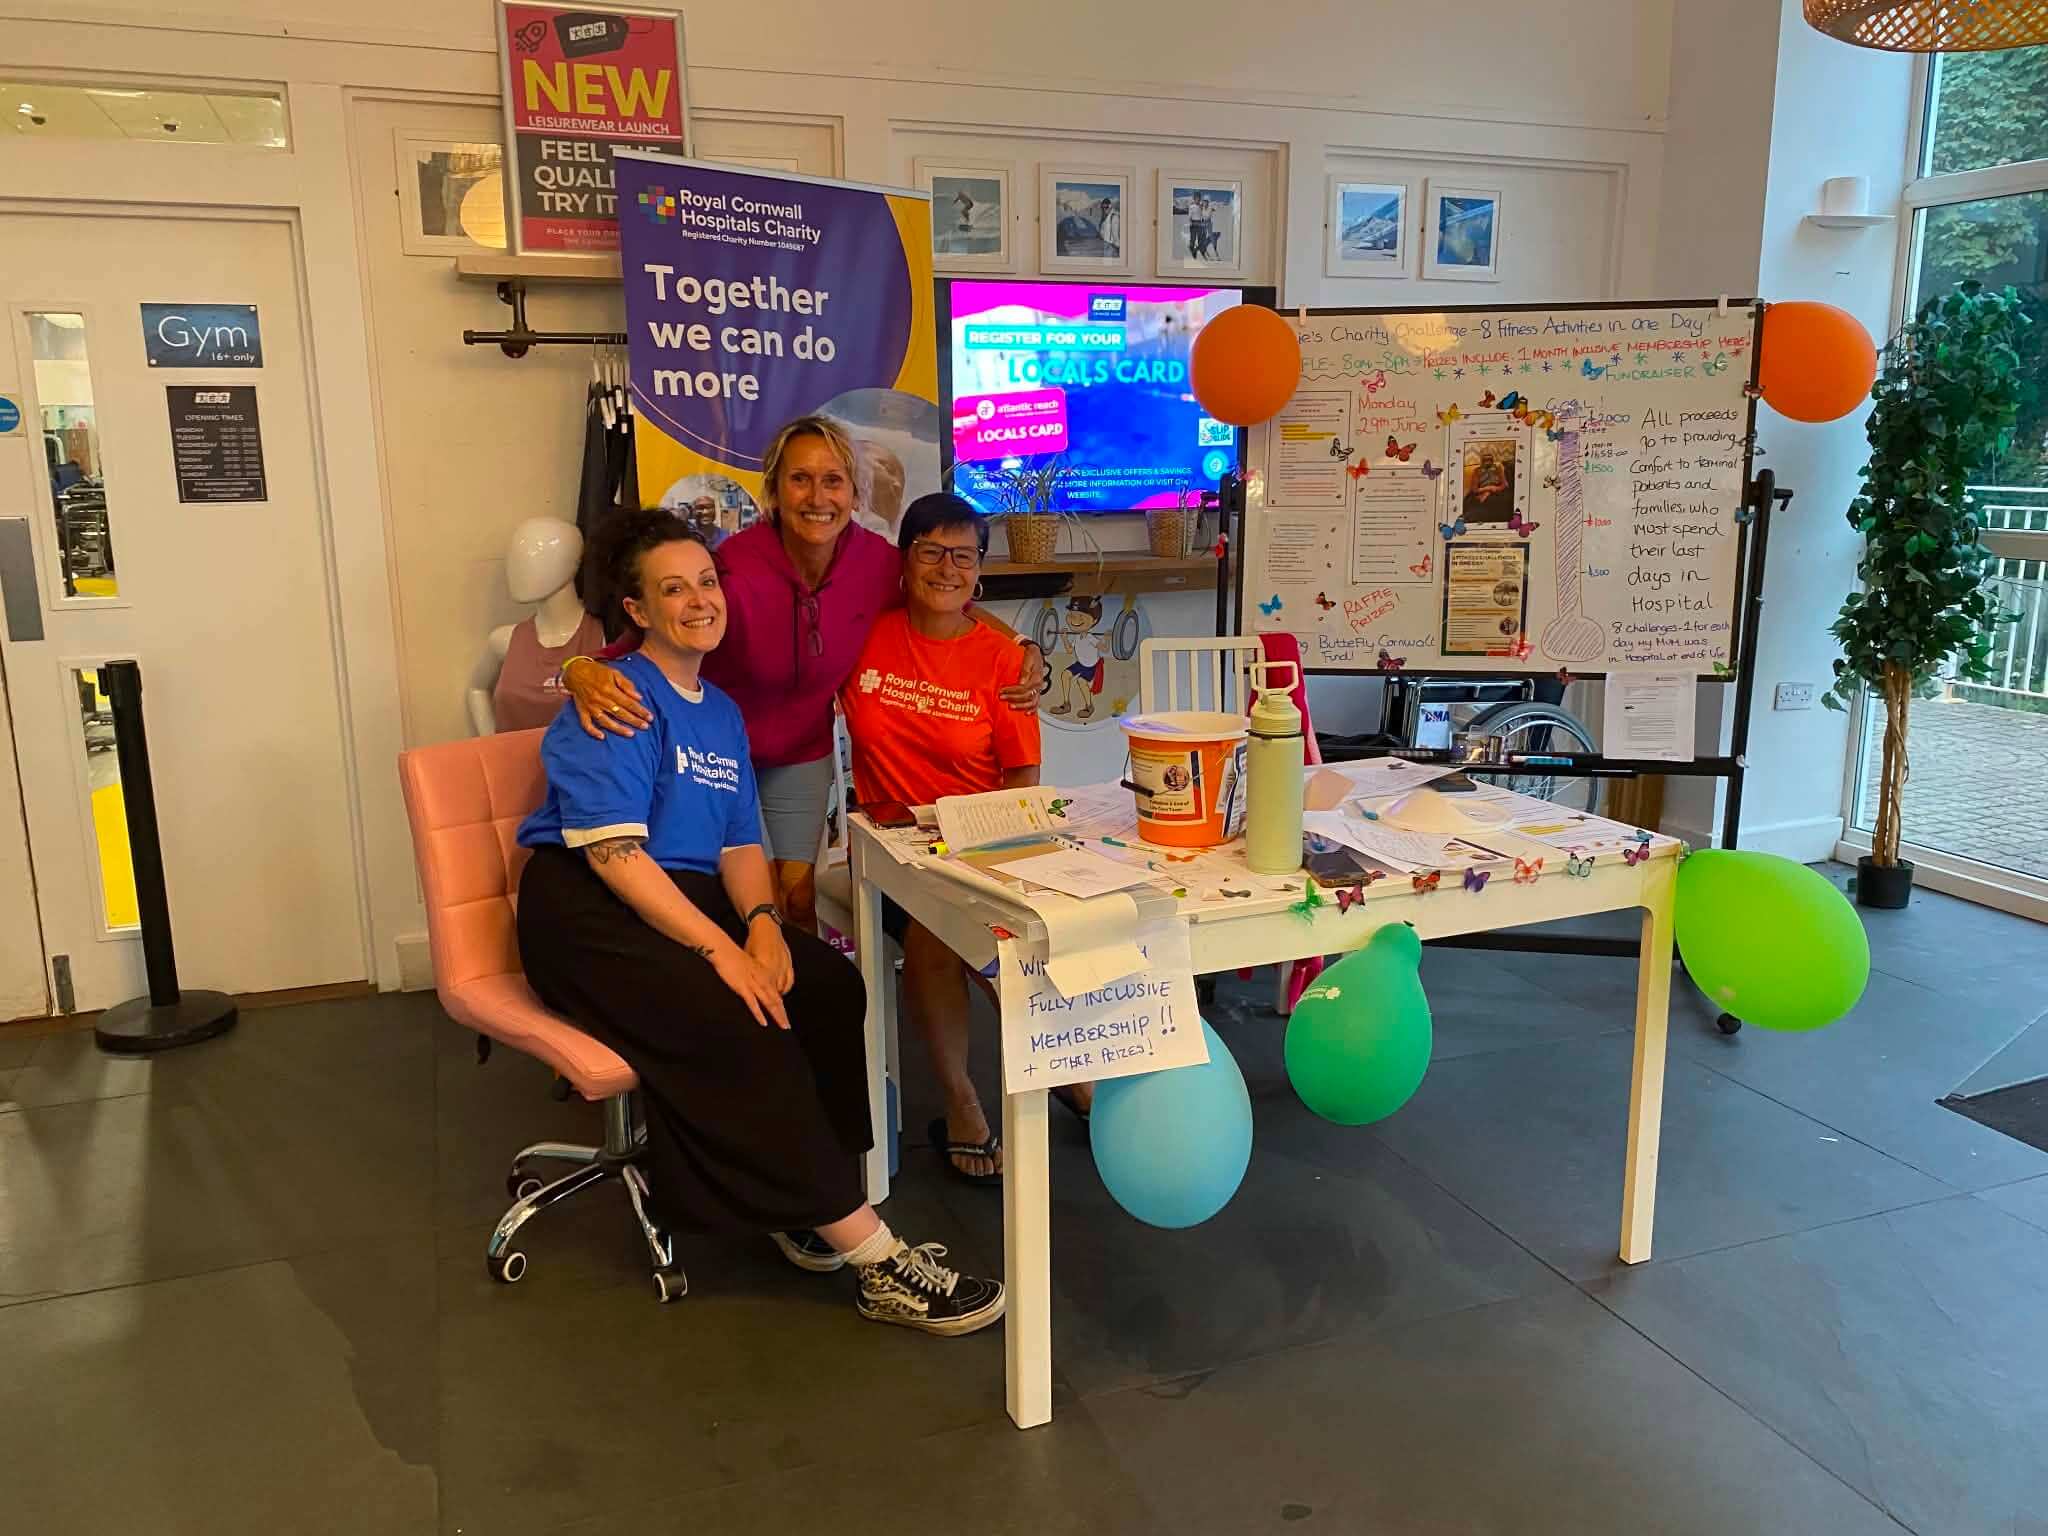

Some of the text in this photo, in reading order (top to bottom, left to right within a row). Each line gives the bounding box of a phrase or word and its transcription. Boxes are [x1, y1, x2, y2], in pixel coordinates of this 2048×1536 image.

[523, 59, 672, 118] NEW
[528, 115, 670, 135] LEISUREWEAR LAUNCH
[541, 139, 606, 163] FEEL
[534, 166, 616, 189] QUALI
[536, 191, 589, 213] TRY
[679, 189, 802, 220] Royal Cornwall
[681, 209, 821, 244] Hospitals Charity
[682, 230, 721, 241] Registered
[721, 234, 747, 245] Charity
[748, 238, 777, 248] Number
[644, 264, 829, 315] Together
[158, 315, 248, 357] Gym
[969, 331, 1121, 345] REGISTER FOR YOUR
[1298, 330, 1324, 345] ie's
[1330, 326, 1389, 345] Charity
[1395, 319, 1467, 342] Challenge
[1498, 318, 1537, 338] Fitness
[1543, 316, 1602, 336] Activities
[648, 321, 836, 362] we can do
[1532, 348, 1567, 360] MONTH
[1627, 339, 1712, 351] MEMBERSHIP
[212, 351, 255, 363] 16+ only
[1008, 357, 1185, 383] LOCALS CARD
[1605, 363, 1696, 381] FUNDRAISER
[653, 369, 760, 400] more
[1358, 392, 1416, 416] Monday
[1391, 416, 1427, 432] June
[1680, 409, 1738, 427] proceeds
[977, 423, 1064, 443] LOCALS CARD
[1640, 435, 1656, 455] go
[1661, 433, 1677, 445] to
[1683, 430, 1736, 451] providing
[1676, 458, 1690, 469] to
[1695, 456, 1738, 469] terminal
[1632, 478, 1718, 498] patients and
[1689, 500, 1719, 515] who
[1672, 521, 1725, 539] spend
[1629, 541, 1705, 558] their last
[1627, 565, 1671, 590] days
[1632, 592, 1713, 613] Hospital
[1612, 621, 1623, 633] 8
[1694, 621, 1708, 632] for
[1613, 637, 1634, 651] day
[886, 673, 970, 700] Royal Cornwall
[881, 684, 981, 716] Hospitals Charity
[1028, 981, 1171, 1017] FULLY INCLUSIVE
[1049, 1053, 1094, 1070] OTHER
